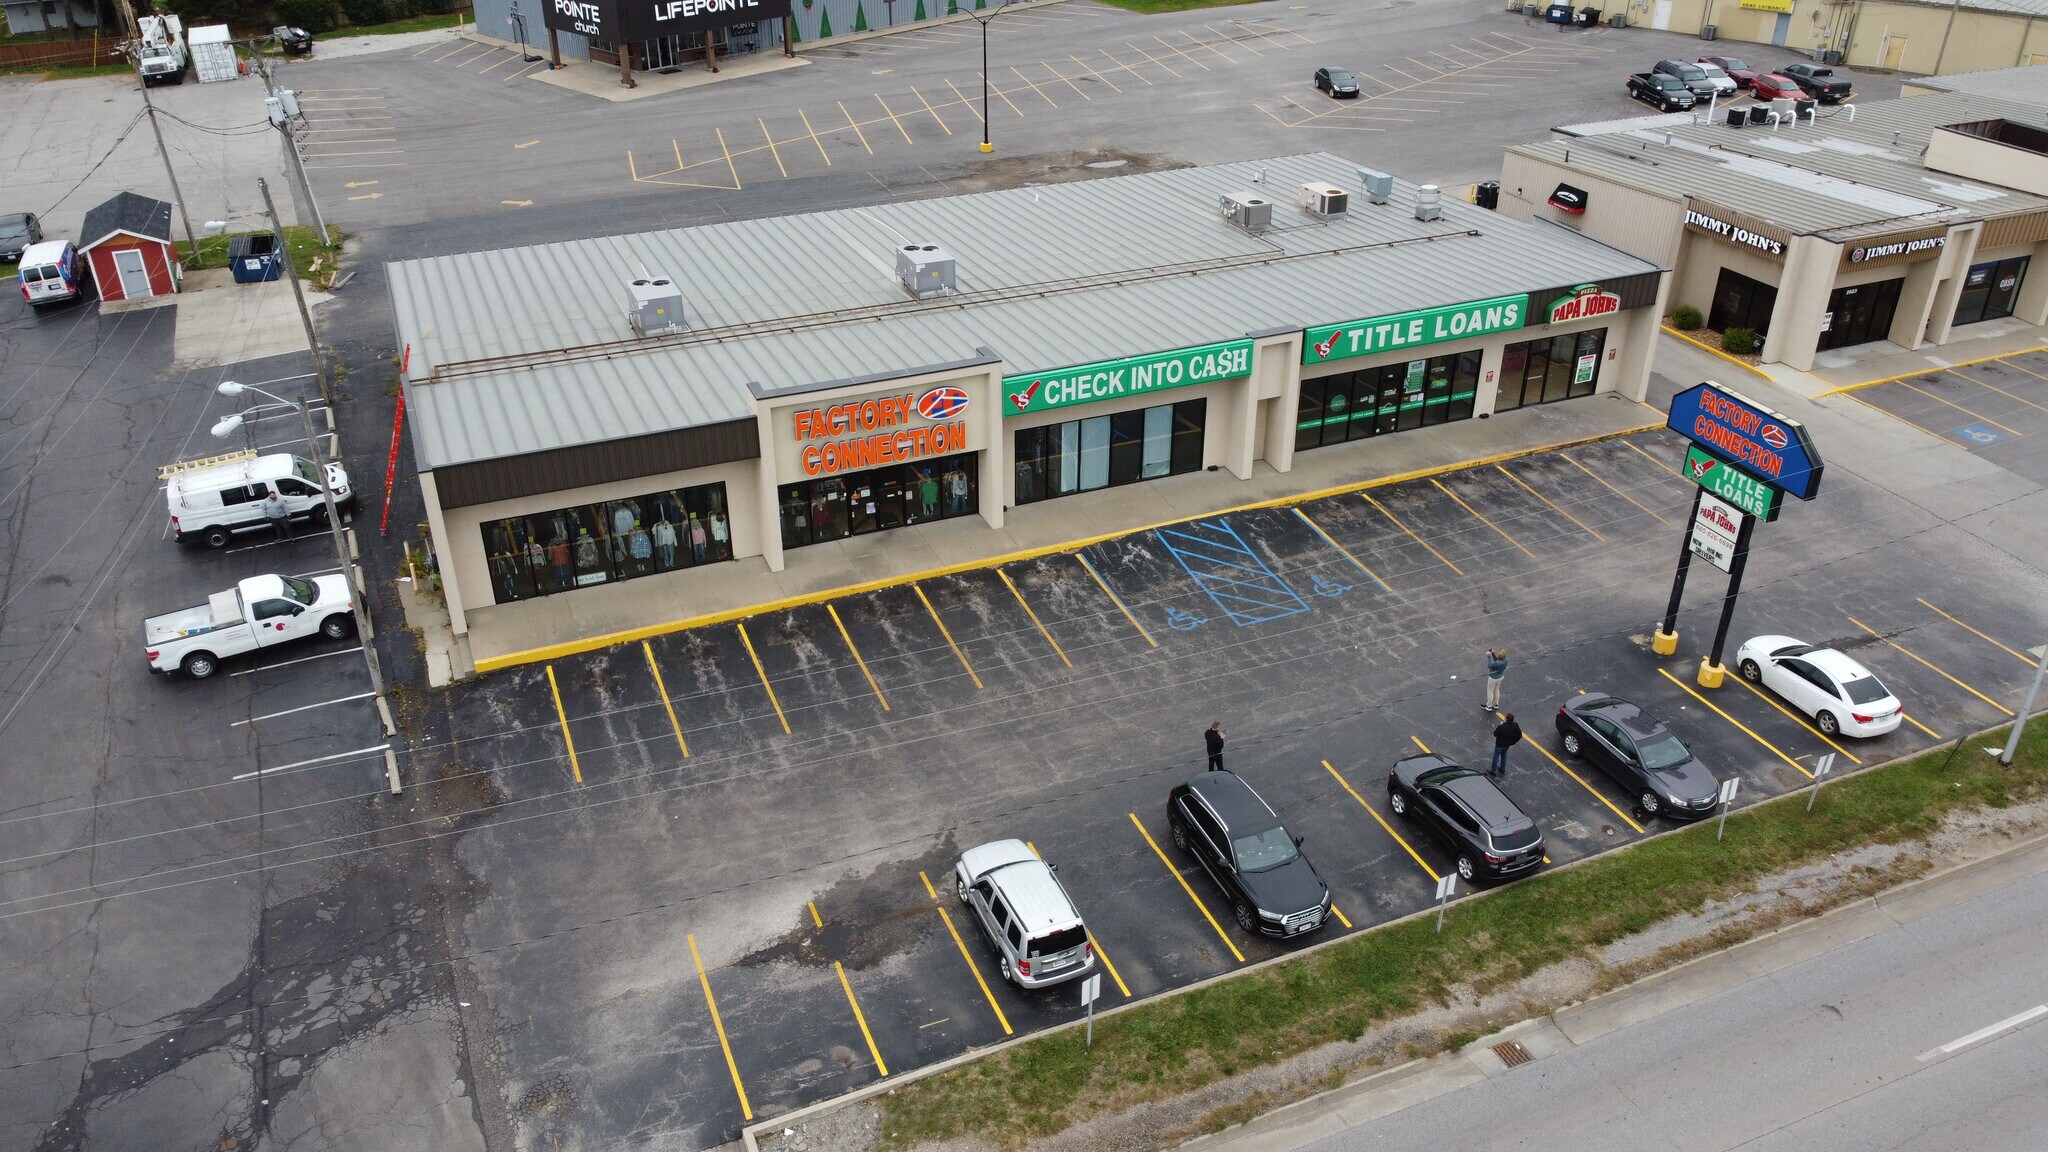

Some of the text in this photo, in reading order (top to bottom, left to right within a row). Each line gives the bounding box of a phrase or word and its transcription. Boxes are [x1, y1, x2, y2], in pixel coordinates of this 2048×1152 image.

[554, 0, 601, 23] POINTE
[574, 20, 600, 36] church
[1684, 209, 1781, 254] JIMMY JOHN'S
[1865, 237, 1946, 261] JIMMY JOHN'S
[1552, 296, 1617, 322] PAPA JOHNS
[1580, 287, 1597, 295] PIZZA
[1348, 303, 1518, 353] TITLE LOANS
[1044, 369, 1125, 405] CHECK
[1131, 360, 1183, 390] INTO
[794, 394, 914, 441] FACTORY
[1698, 389, 1763, 436] FACTORY
[801, 421, 967, 477] CONNECTION
[1694, 414, 1784, 478] CONNECTION
[1714, 478, 1764, 515] LOANS
[1722, 465, 1765, 500] TITLE
[1700, 507, 1737, 534] PAPA JOHNS
